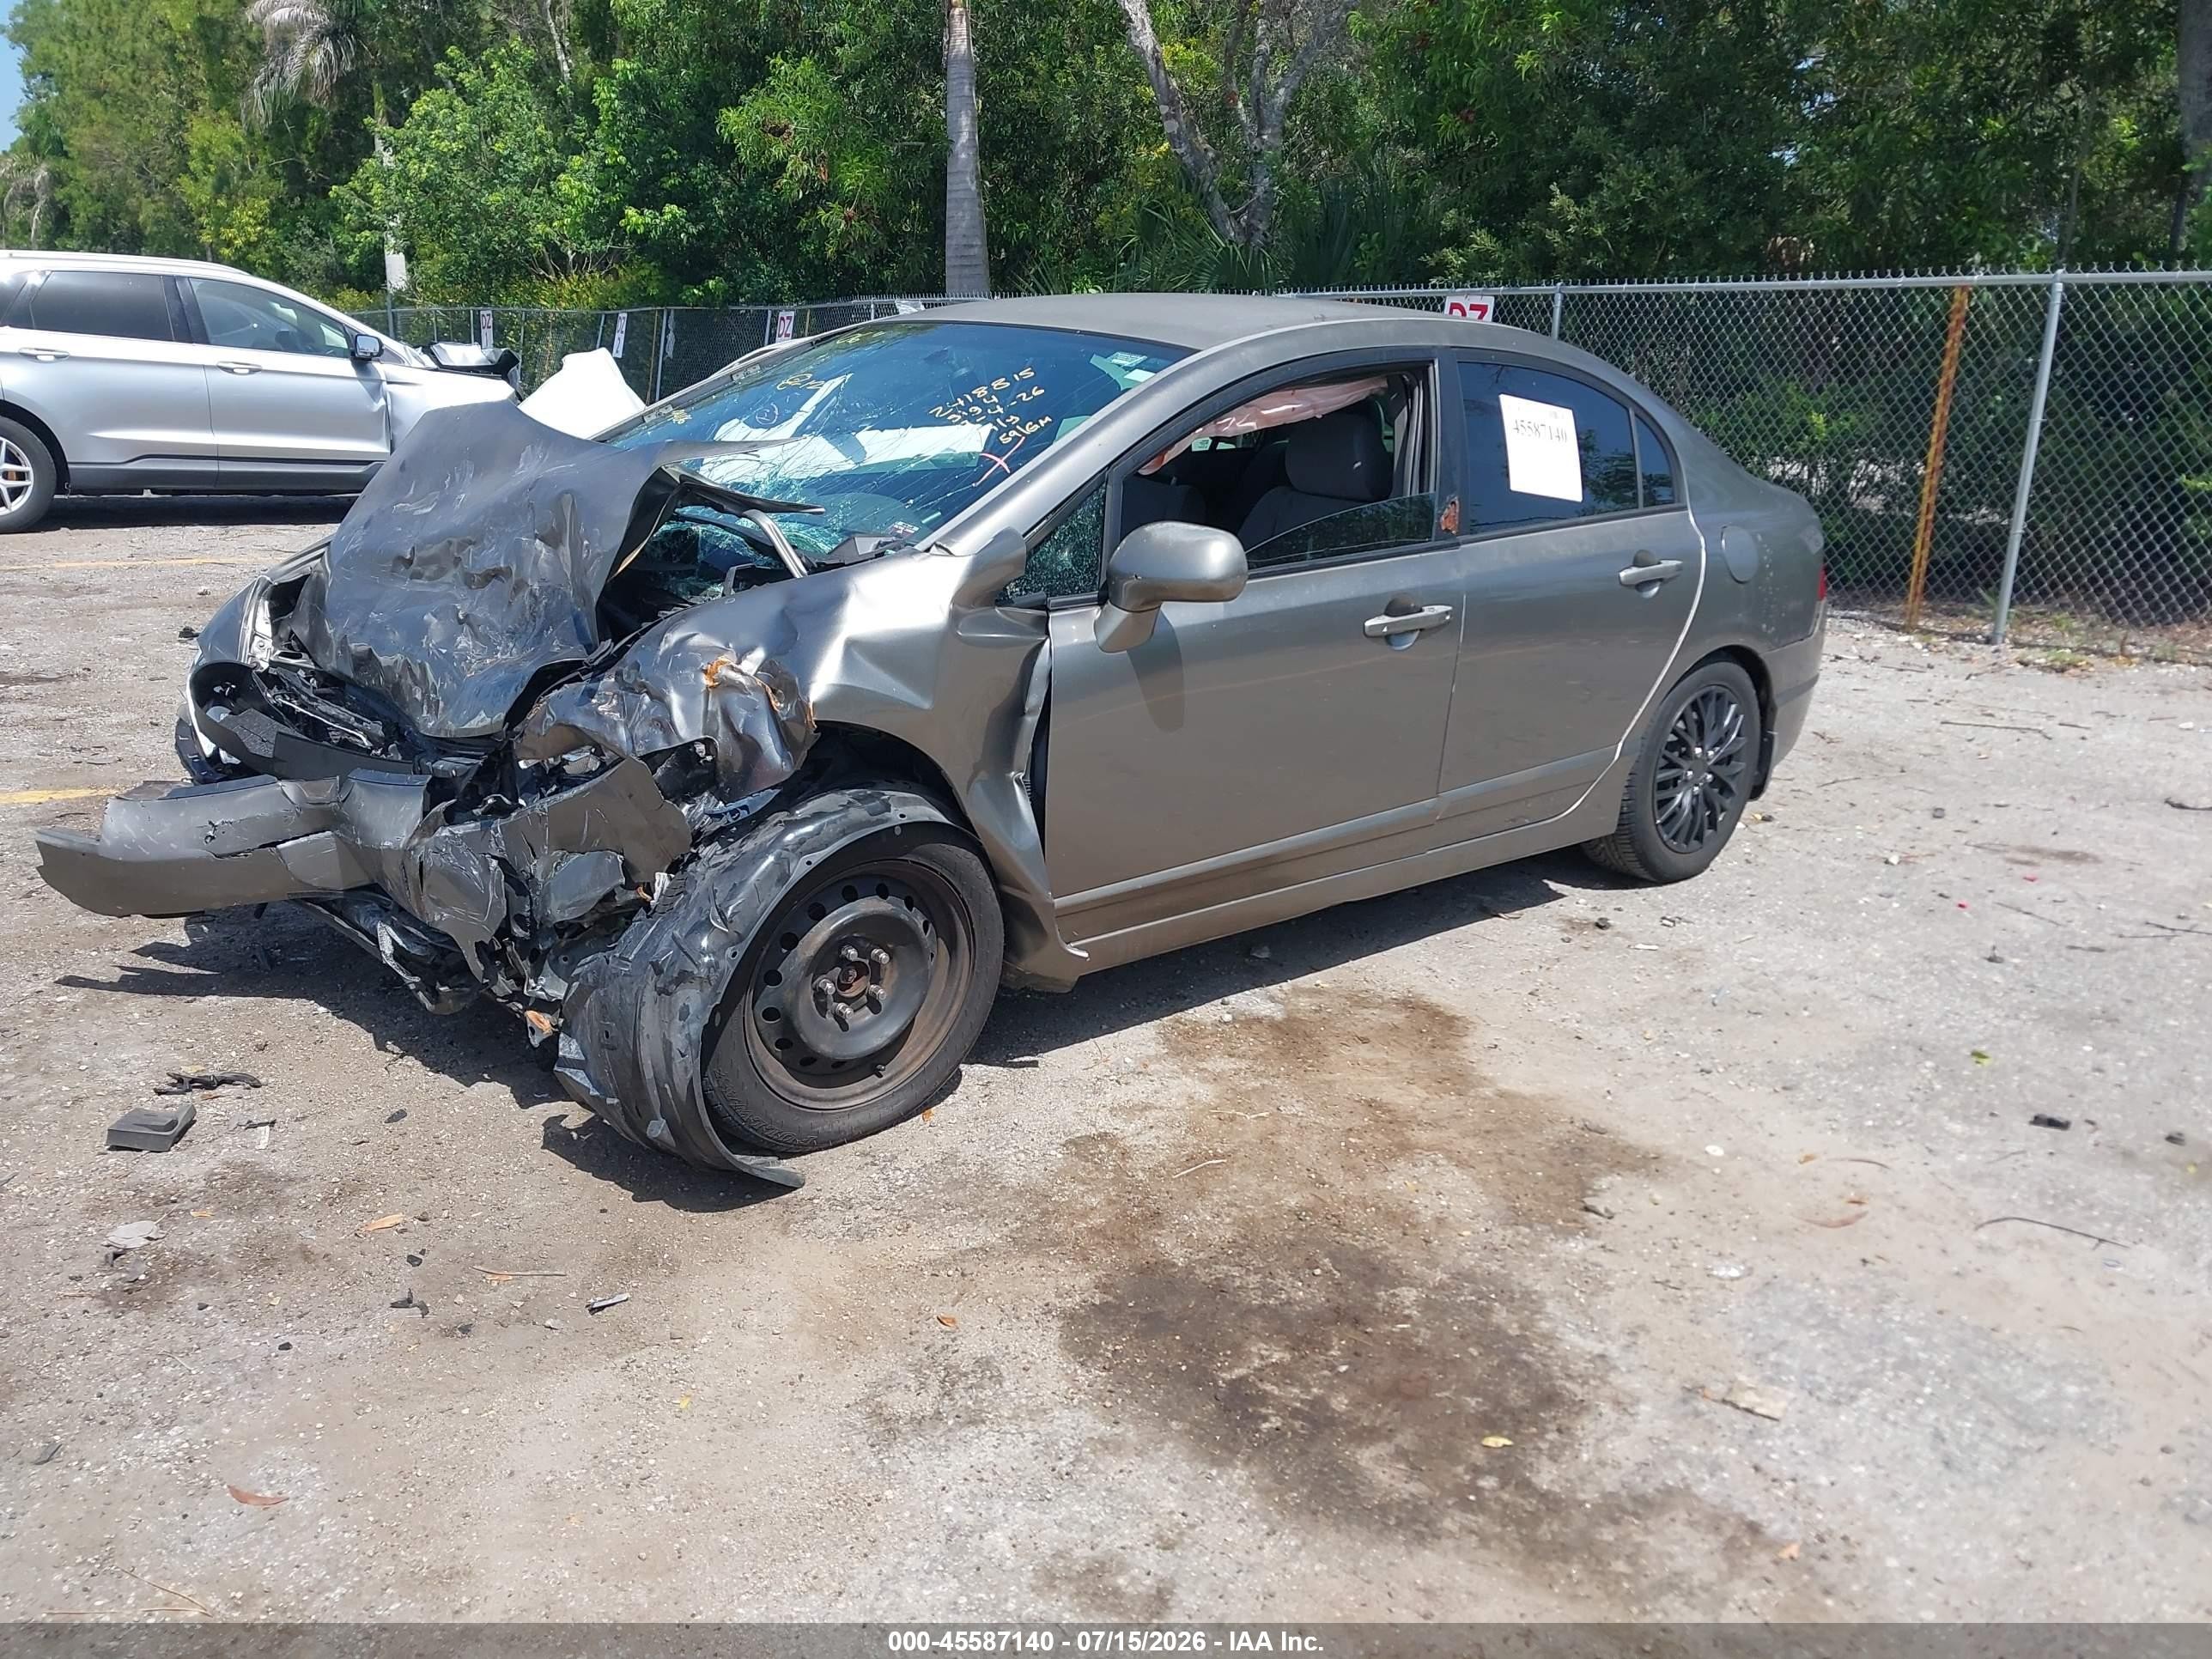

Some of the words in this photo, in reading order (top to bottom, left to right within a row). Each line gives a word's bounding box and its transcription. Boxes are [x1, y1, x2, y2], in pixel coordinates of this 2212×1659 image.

[481, 313, 491, 330] DZ
[617, 316, 626, 334] DZ
[777, 315, 793, 337] DZ
[1512, 418, 1568, 444] 45587140
